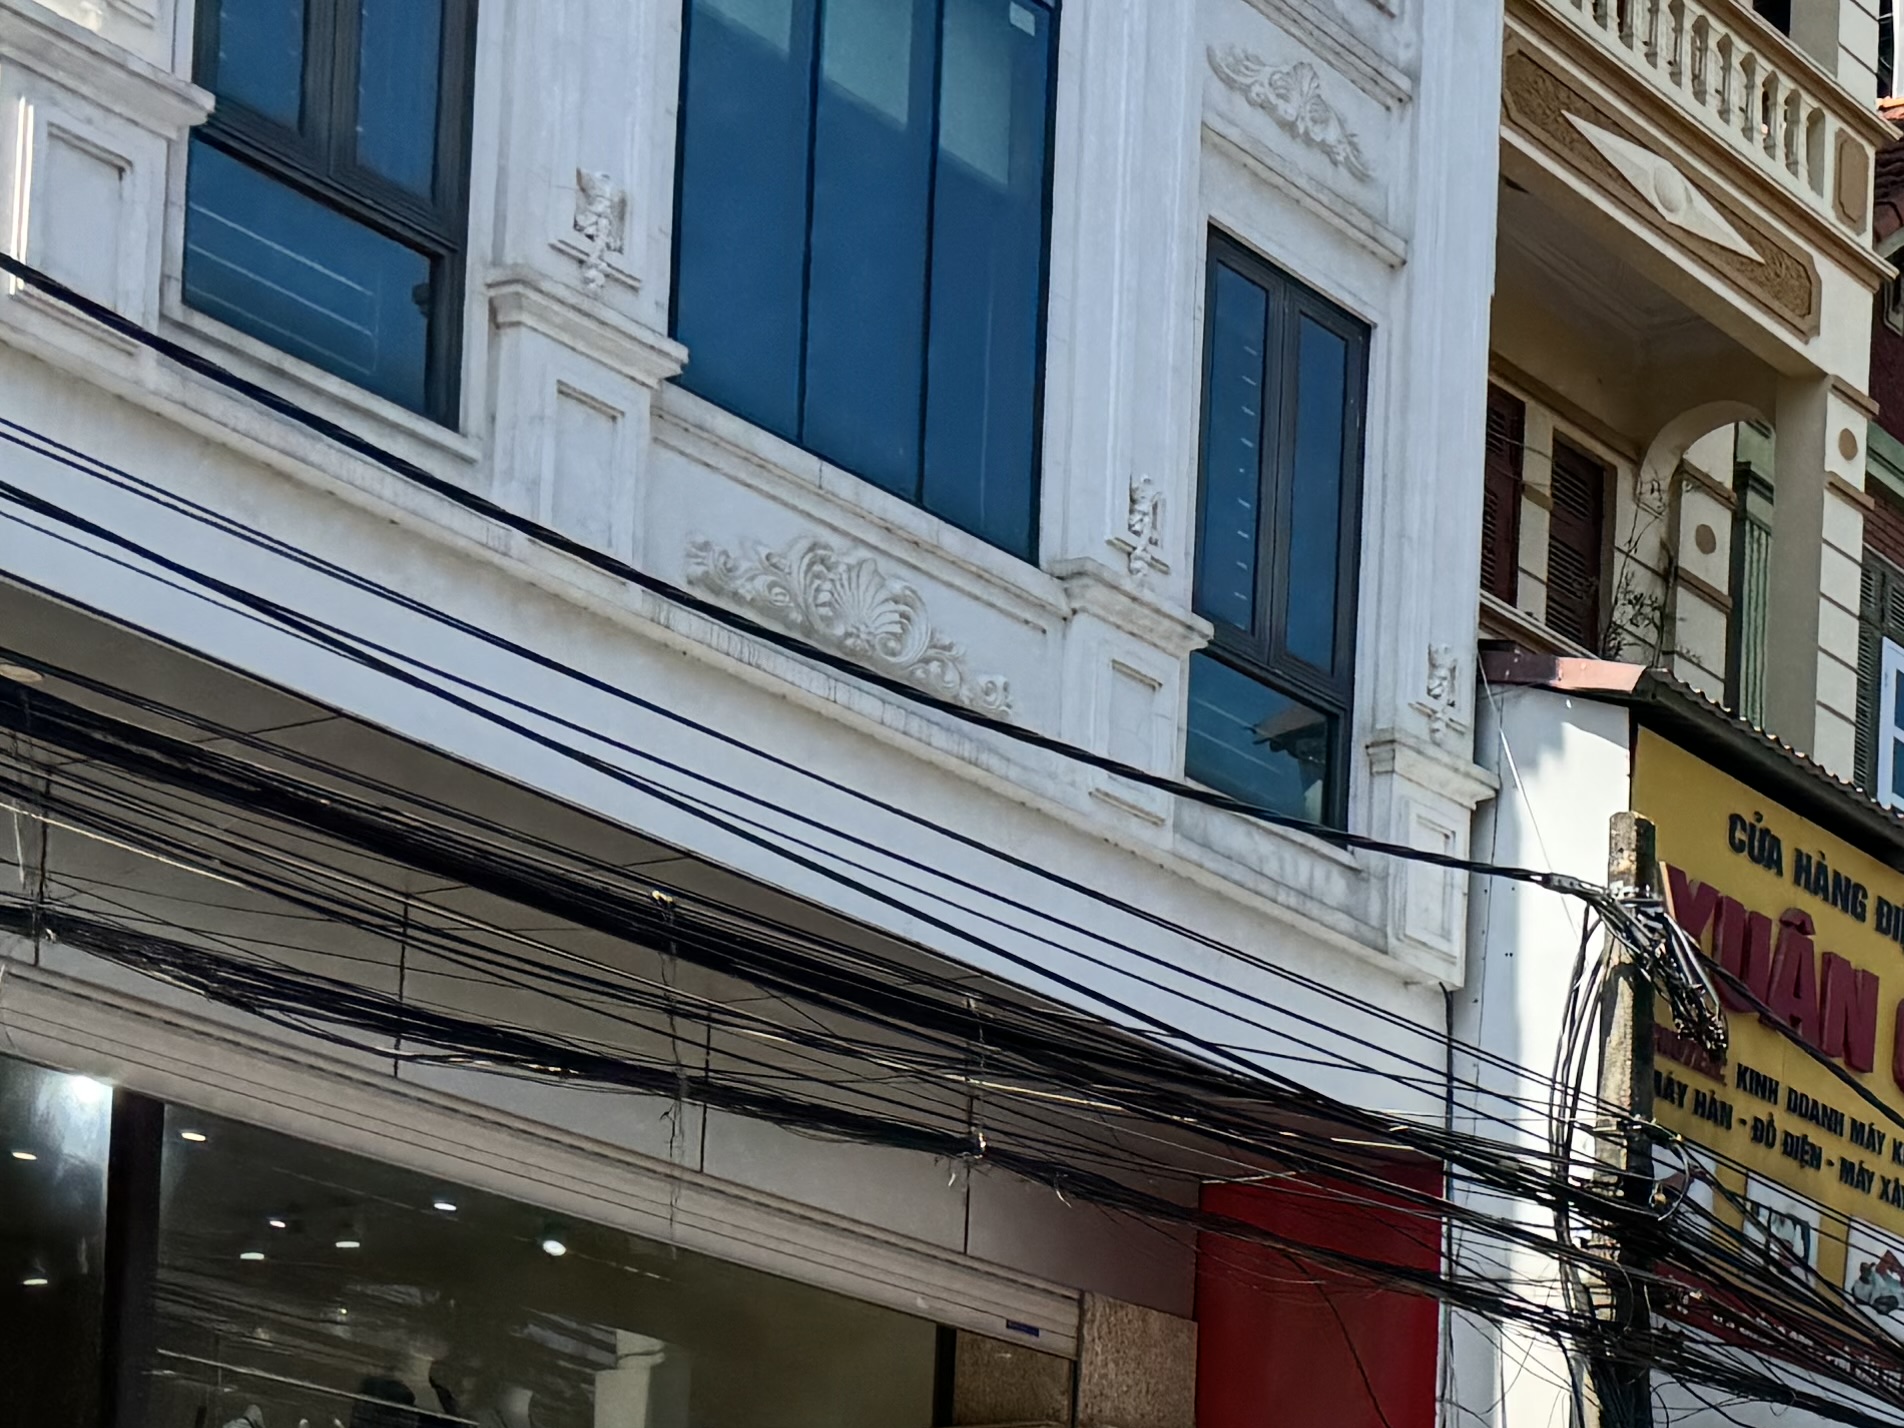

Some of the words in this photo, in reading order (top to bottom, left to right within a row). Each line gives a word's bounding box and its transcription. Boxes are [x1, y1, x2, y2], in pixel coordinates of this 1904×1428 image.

[1728, 811, 1783, 877] CỬA
[1793, 847, 1868, 923] HÀNG
[1693, 1088, 1734, 1131] HÀN
[1751, 1111, 1777, 1149] ĐỒ
[1782, 1130, 1822, 1172] ĐIỆN
[1839, 1157, 1875, 1195] MÁY
[1736, 1063, 1780, 1105] KINH
[1786, 1086, 1845, 1138] DOANH
[1849, 1116, 1886, 1156] MÁY
